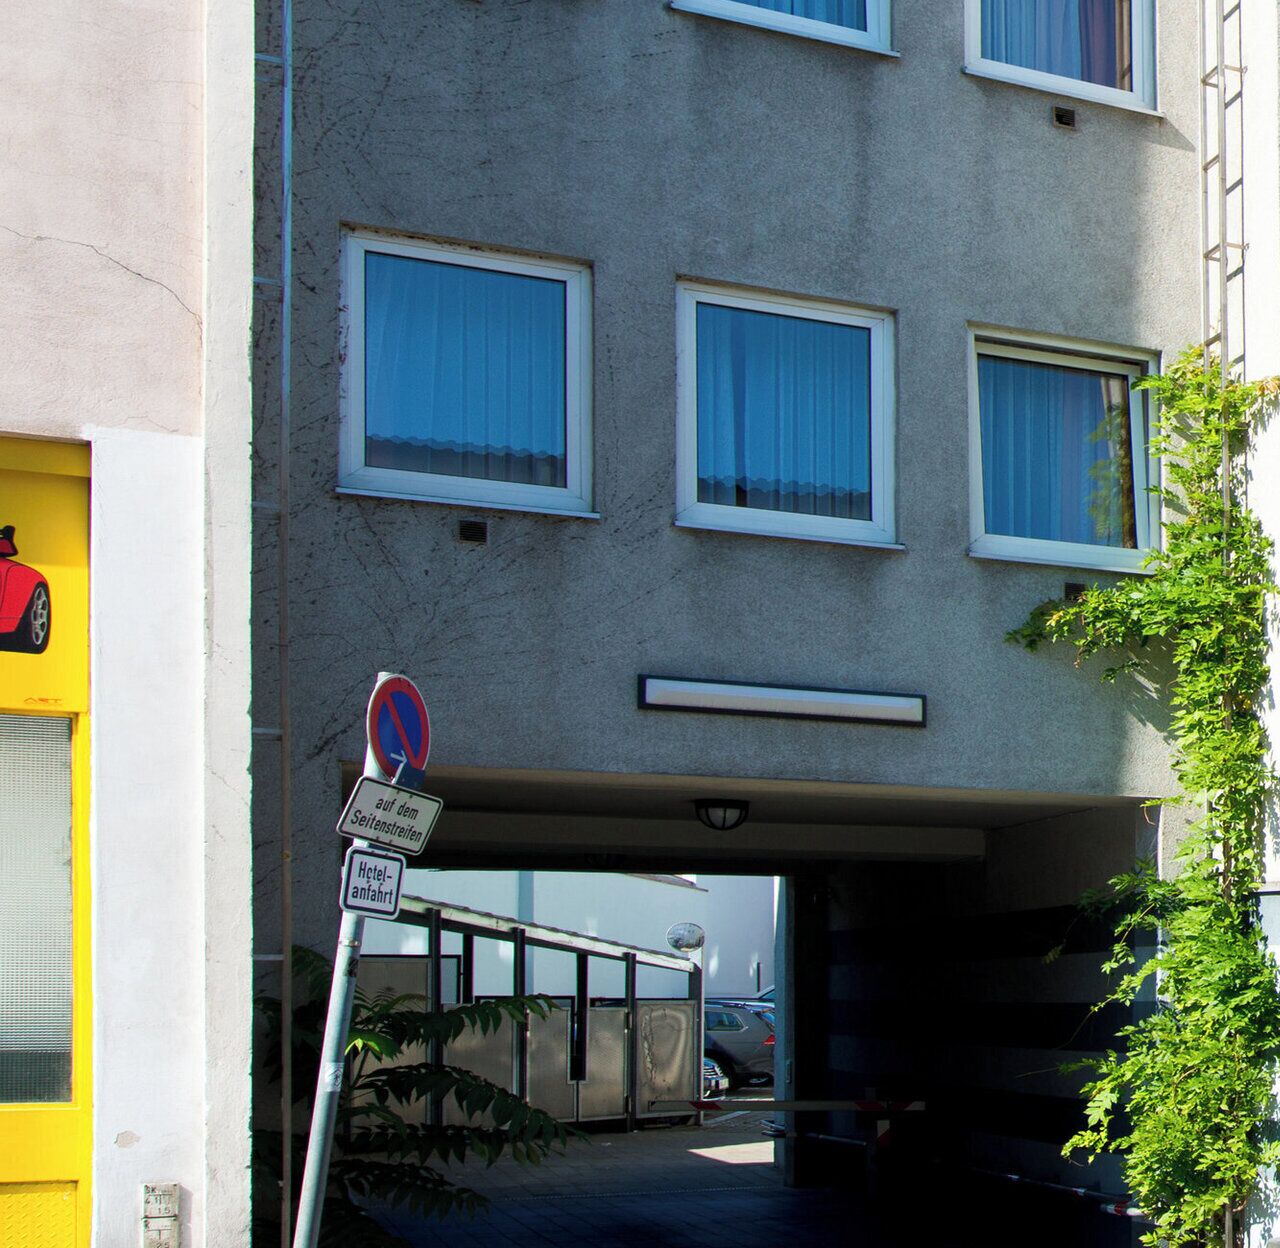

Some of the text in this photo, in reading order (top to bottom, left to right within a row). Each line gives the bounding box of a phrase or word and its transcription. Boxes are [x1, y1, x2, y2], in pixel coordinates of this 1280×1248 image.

[375, 798, 419, 820] auf dem
[350, 809, 423, 843] Seitenstreifen
[358, 860, 392, 883] Hotel-
[352, 883, 394, 904] anfahrt
